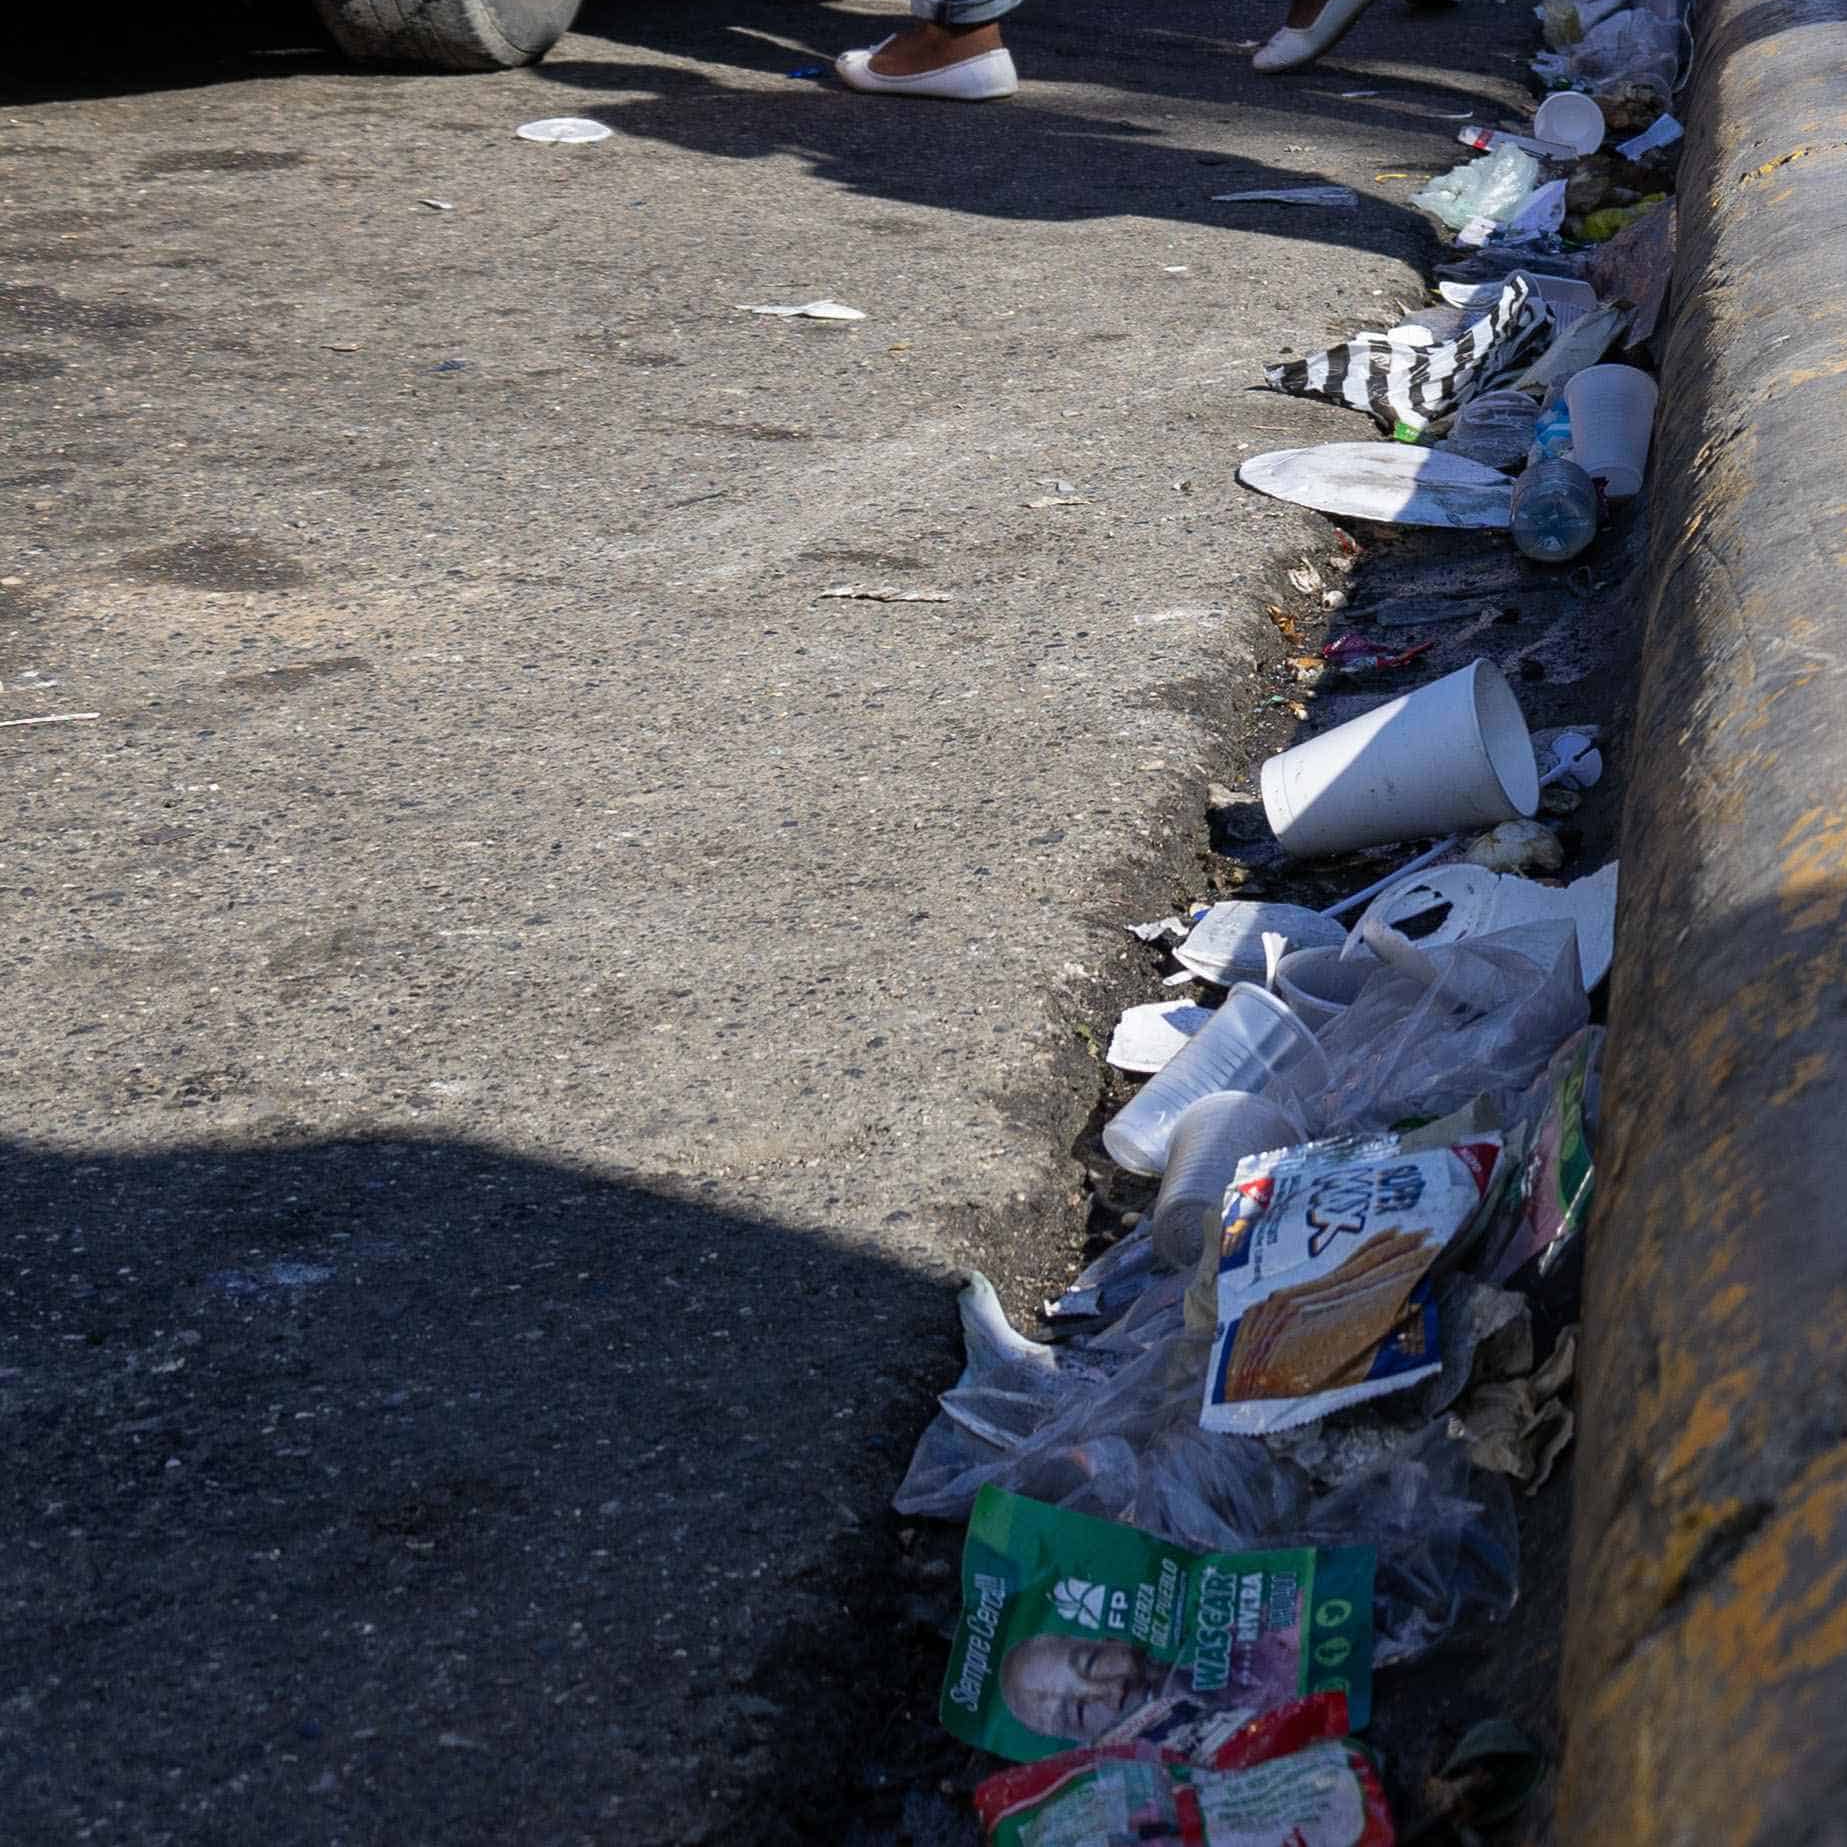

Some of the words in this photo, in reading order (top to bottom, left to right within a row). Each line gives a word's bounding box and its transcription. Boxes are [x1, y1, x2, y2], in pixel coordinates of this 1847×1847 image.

[1106, 1589, 1129, 1630] FP
[1131, 1582, 1156, 1643] FUERZA
[1154, 1557, 1178, 1618] PUEBLO
[1236, 1571, 1264, 1642] RIVERA
[1150, 1621, 1170, 1650] DEL
[1192, 1570, 1237, 1691] WASCAR
[949, 1634, 993, 1712] Siempre
